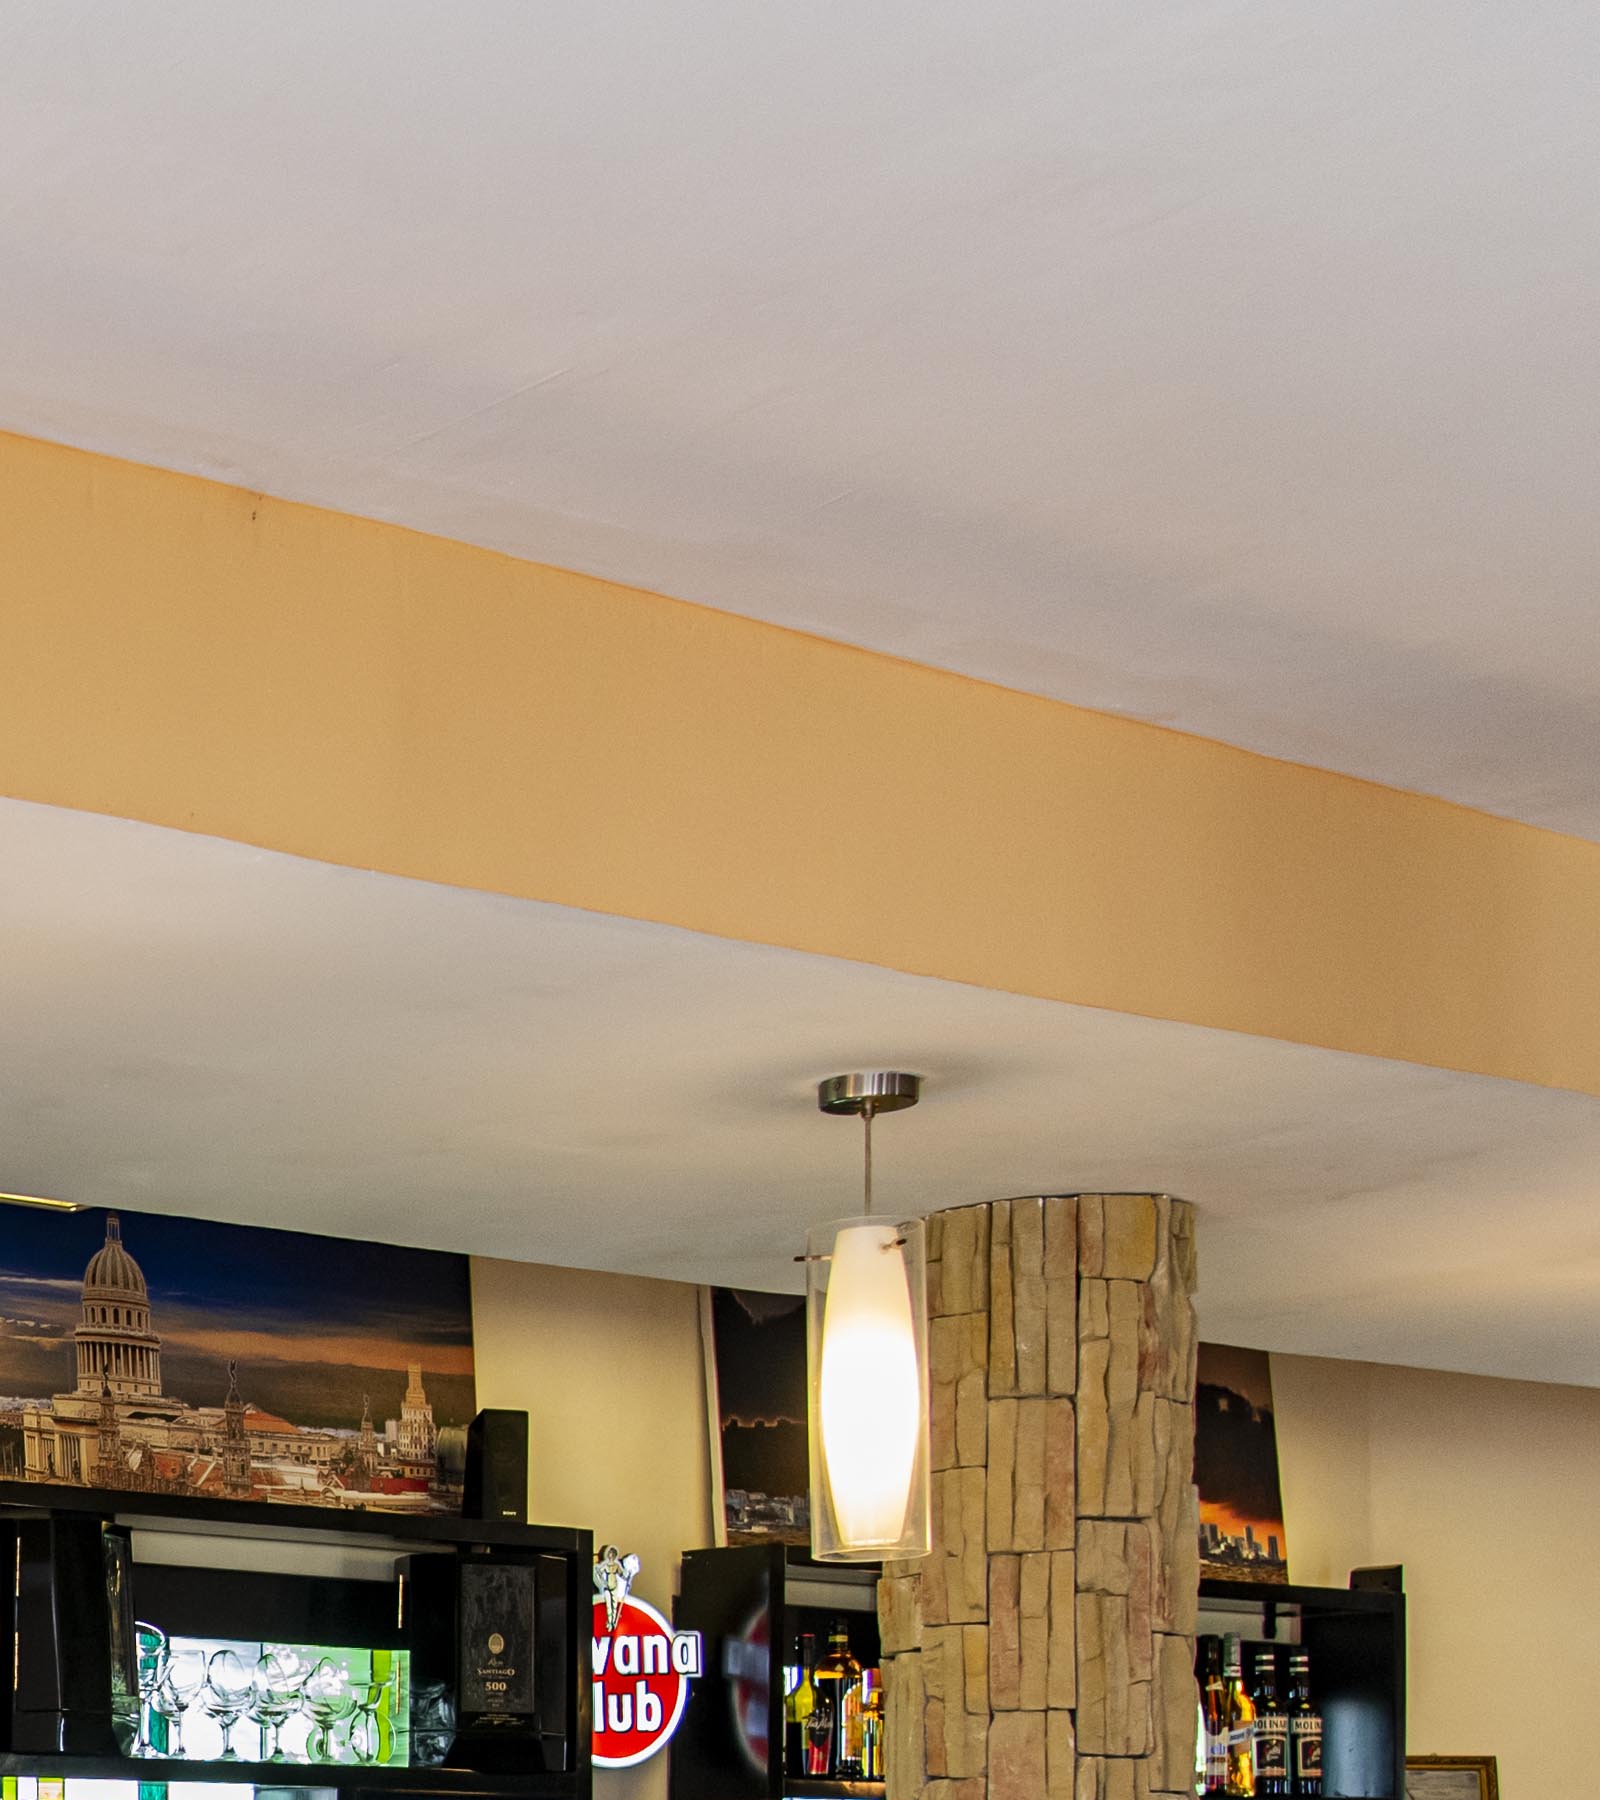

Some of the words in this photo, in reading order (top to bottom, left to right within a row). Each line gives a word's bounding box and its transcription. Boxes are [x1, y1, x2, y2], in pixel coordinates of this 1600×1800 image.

[592, 1633, 699, 1676] vana
[477, 1667, 515, 1676] SANTIAGO
[485, 1681, 507, 1691] 500
[592, 1680, 662, 1732] lub
